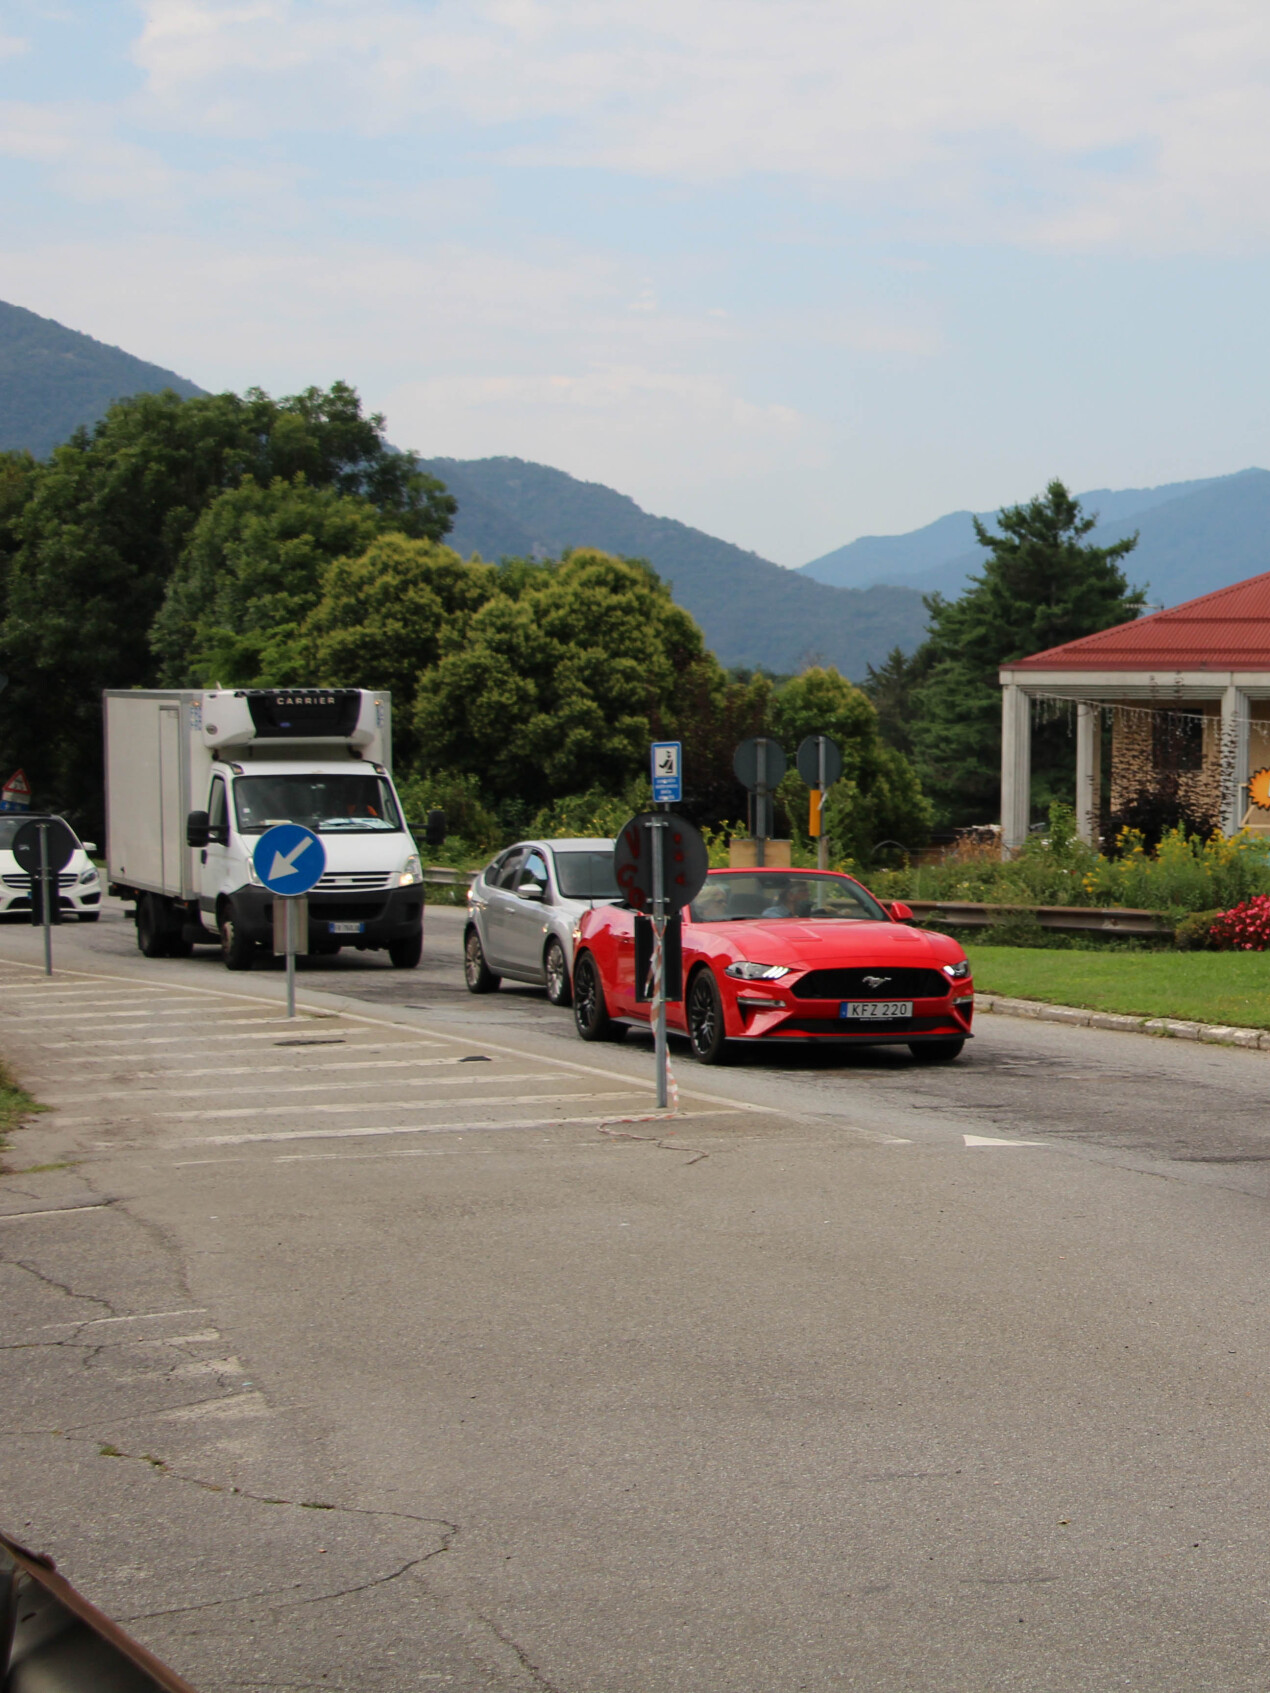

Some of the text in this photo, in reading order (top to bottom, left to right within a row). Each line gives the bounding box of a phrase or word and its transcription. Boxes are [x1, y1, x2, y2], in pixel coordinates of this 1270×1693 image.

[276, 697, 335, 705] CARRIER
[852, 1004, 907, 1016] KFZ 220
